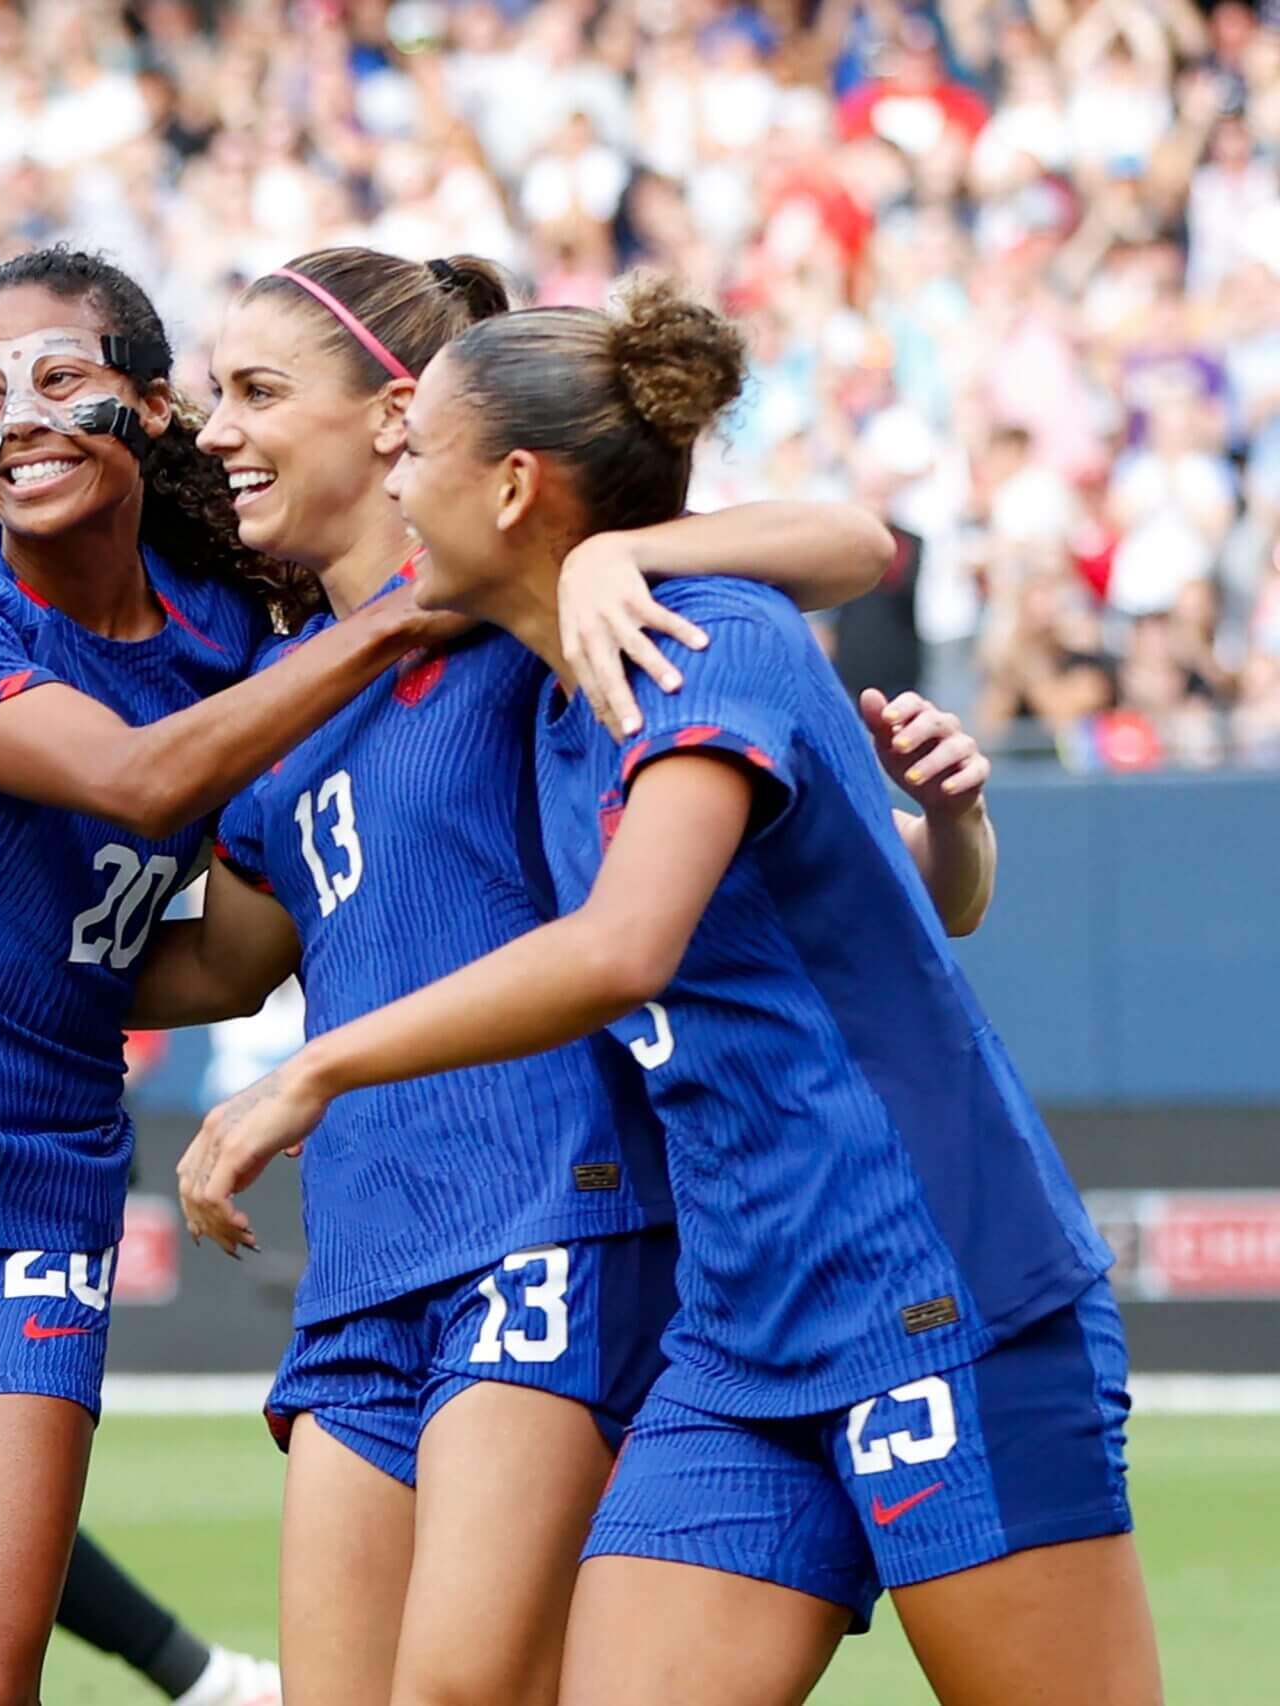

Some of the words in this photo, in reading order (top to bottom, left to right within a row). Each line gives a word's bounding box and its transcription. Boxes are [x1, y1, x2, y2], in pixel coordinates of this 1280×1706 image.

[68, 843, 178, 968] 20
[295, 770, 363, 917] 13
[470, 1246, 569, 1362] 13
